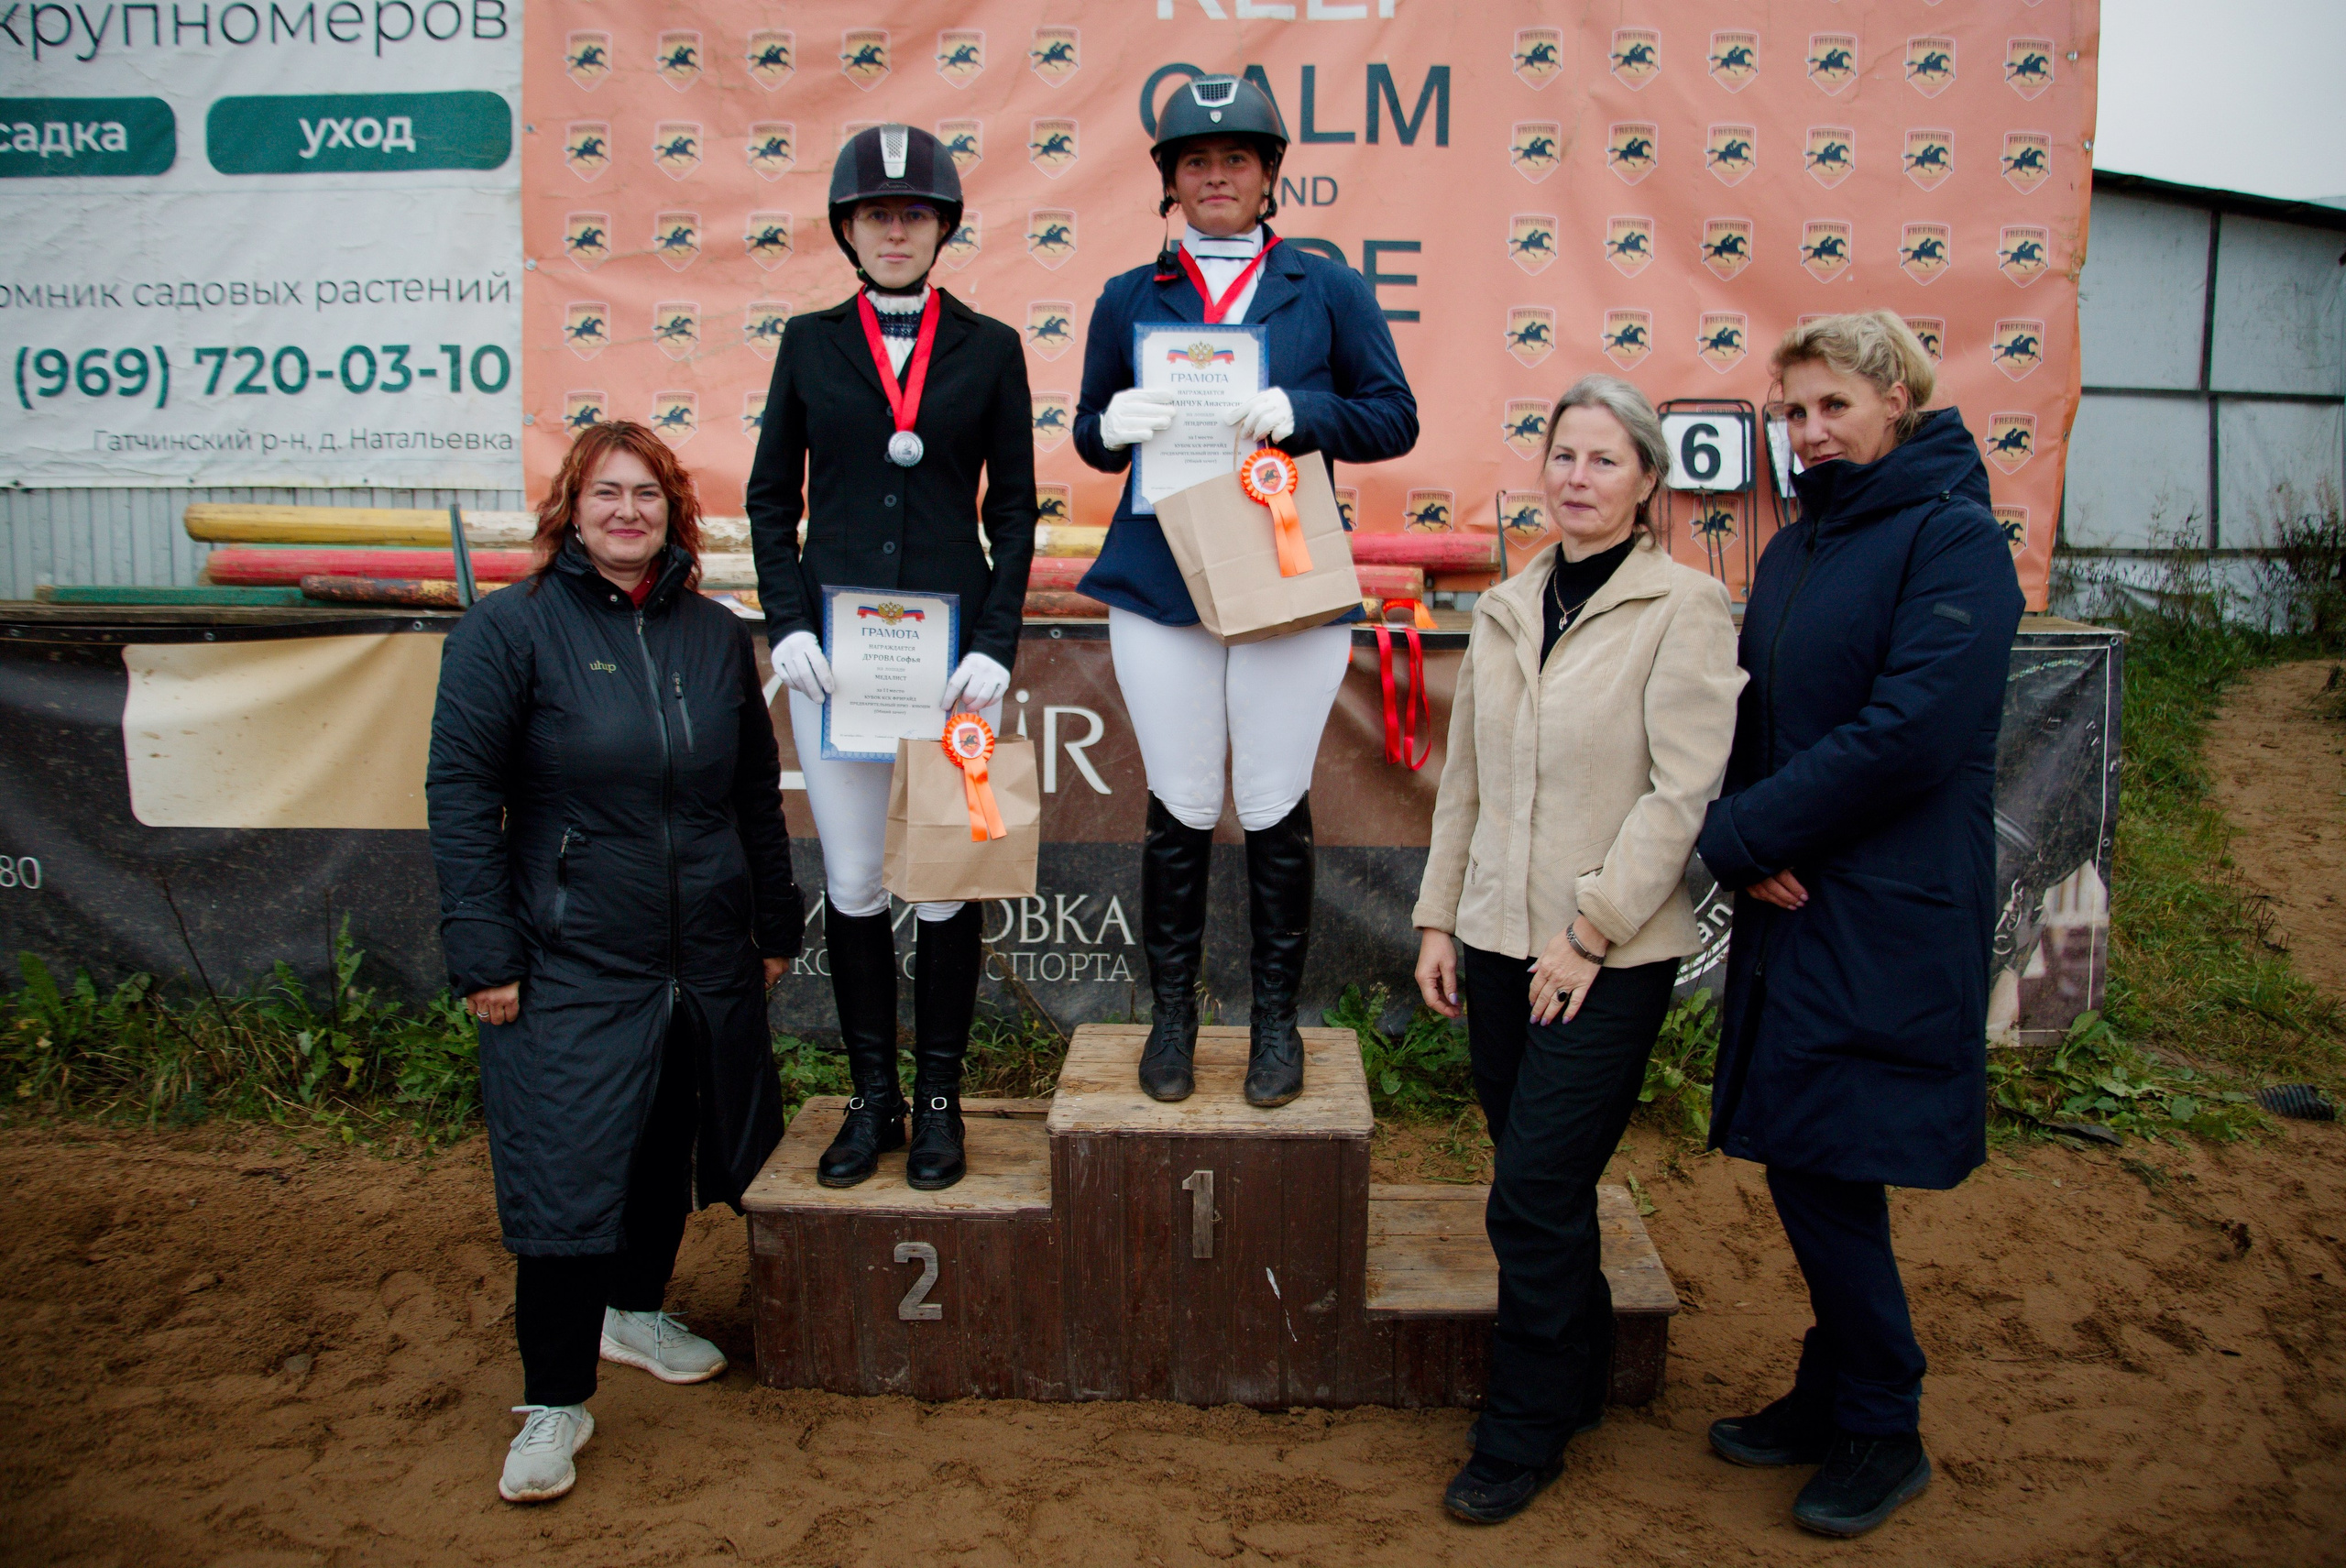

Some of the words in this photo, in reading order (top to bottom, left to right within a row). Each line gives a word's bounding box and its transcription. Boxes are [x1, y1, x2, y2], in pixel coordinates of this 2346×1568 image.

[0, 1, 509, 61] крупномеров
[1617, 33, 1655, 42] FREERIDE
[1716, 34, 1754, 44] FREERIDE
[1814, 38, 1852, 47] FREERIDE
[1912, 39, 1950, 49] FREERIDE
[2012, 41, 2049, 52] FREERIDE
[1615, 126, 1652, 136] FREERIDE
[1714, 128, 1751, 137] FREERIDE
[1812, 130, 1850, 140] FREERIDE
[298, 116, 417, 159] уход
[1910, 133, 1949, 142] FREERIDE
[2009, 136, 2046, 146] FREERIDE
[1280, 176, 1338, 207] ND
[1515, 218, 1552, 227] FREERIDE
[1613, 220, 1650, 229] FREERIDE
[1709, 222, 1748, 232] FREERIDE
[1808, 225, 1847, 234] FREERIDE
[1907, 225, 1945, 236] FREERIDE
[2005, 228, 2044, 238] FREERIDE
[133, 279, 301, 311] садовых
[315, 271, 511, 311] растений
[1512, 310, 1551, 320] FREERIDE
[1609, 312, 1648, 322] FREERIDE
[1705, 316, 1743, 326] FREERIDE
[1906, 321, 1940, 331] REERIDE
[2000, 323, 2039, 333] FREERIDE
[15, 345, 170, 410] (969)
[193, 344, 511, 395] 720-03-10
[1170, 373, 1229, 383] ГРАМОТА
[1509, 403, 1548, 412] FREERIDE
[1994, 416, 2033, 427] FREERIDE
[93, 427, 254, 451] Гатчинский
[262, 431, 312, 455] р-н,
[319, 431, 342, 453] д.
[350, 427, 513, 451] Натальевка
[1681, 423, 1721, 480] 6
[1412, 492, 1450, 502] FREERIDE
[1992, 509, 2024, 519] REERIDE
[861, 627, 920, 640] ГРАМОТА
[862, 653, 894, 662] ДУРОВА
[896, 655, 921, 663] Софья
[986, 952, 1135, 982] СПОРТА
[1182, 1170, 1213, 1258] 1
[893, 1242, 942, 1320] 2
